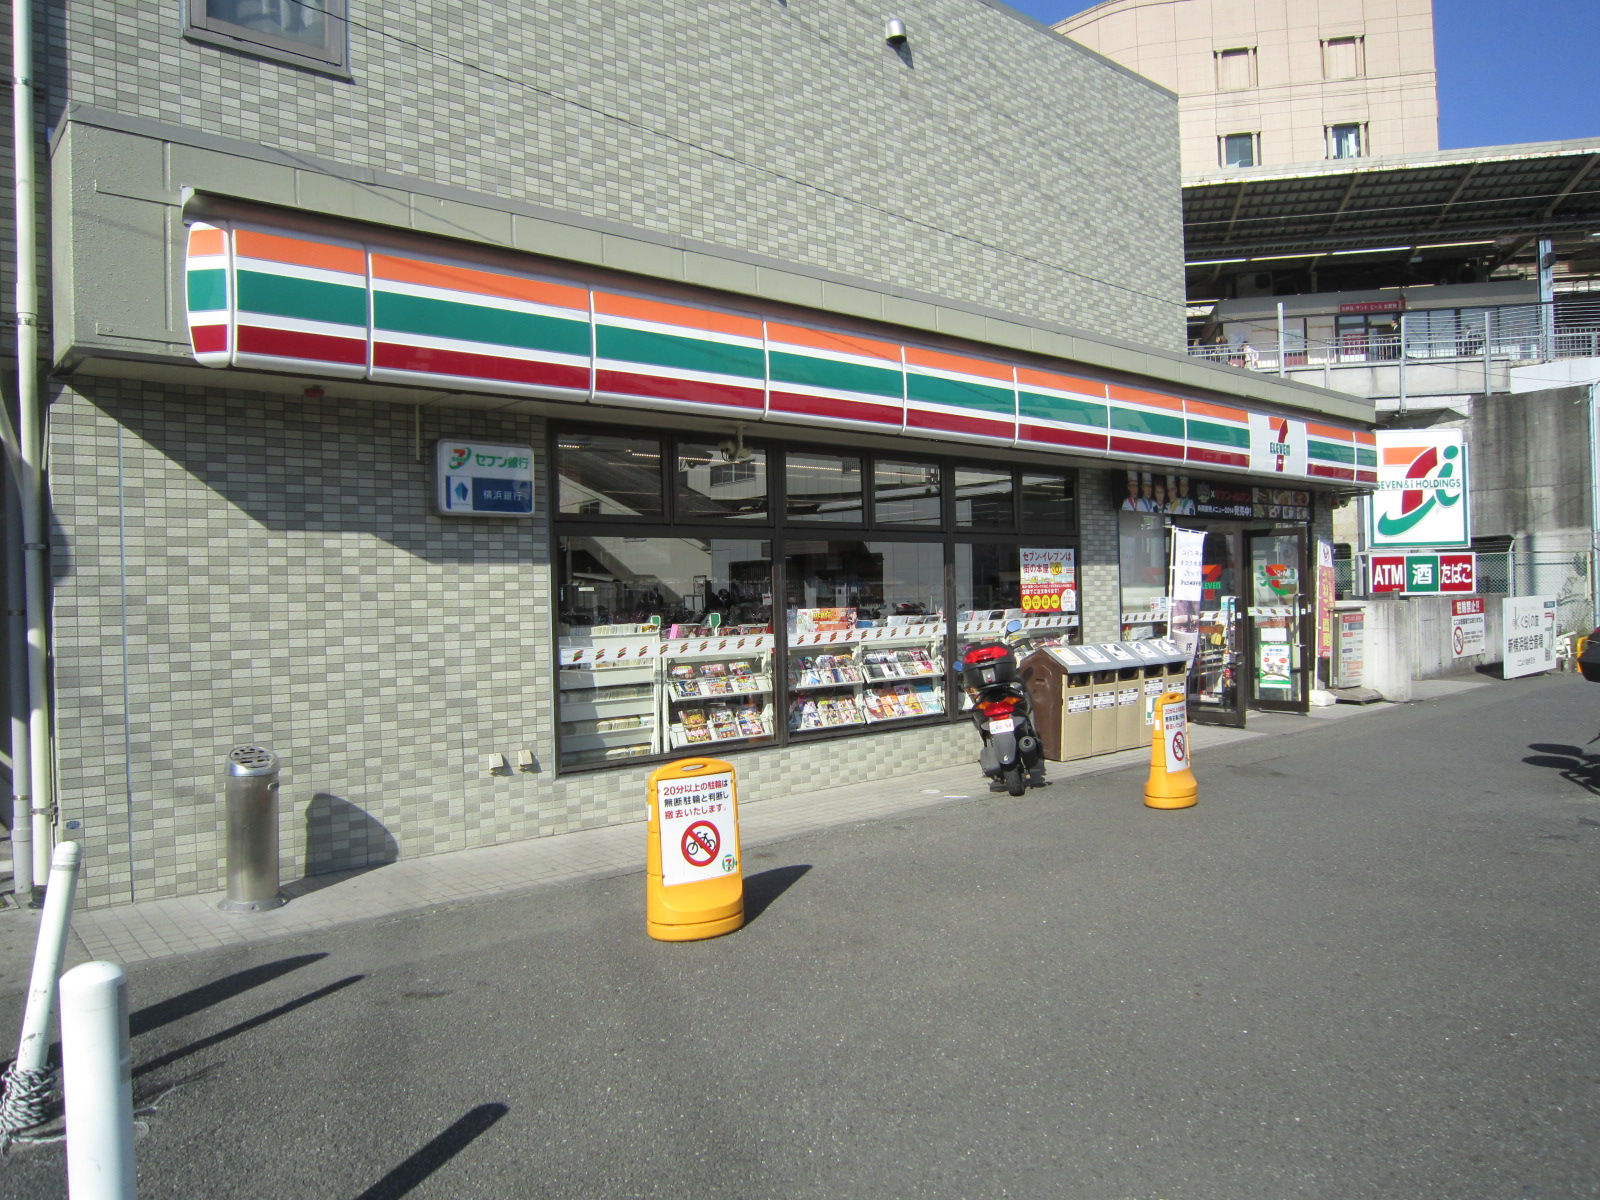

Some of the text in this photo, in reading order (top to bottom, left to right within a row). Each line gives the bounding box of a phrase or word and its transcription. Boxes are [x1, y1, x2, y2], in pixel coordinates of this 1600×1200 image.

[475, 453, 529, 469] セブン銀行
[1416, 479, 1461, 488] HOLDINGS
[483, 490, 522, 501] 横浜銀行
[1023, 563, 1049, 574] 街の本屋
[1374, 564, 1404, 585] ATM
[1412, 564, 1433, 585] 酒
[1441, 562, 1472, 584] たばこ
[663, 780, 728, 795] 20分以上の駐輪は
[664, 791, 728, 807] 無断駐輪と判断し
